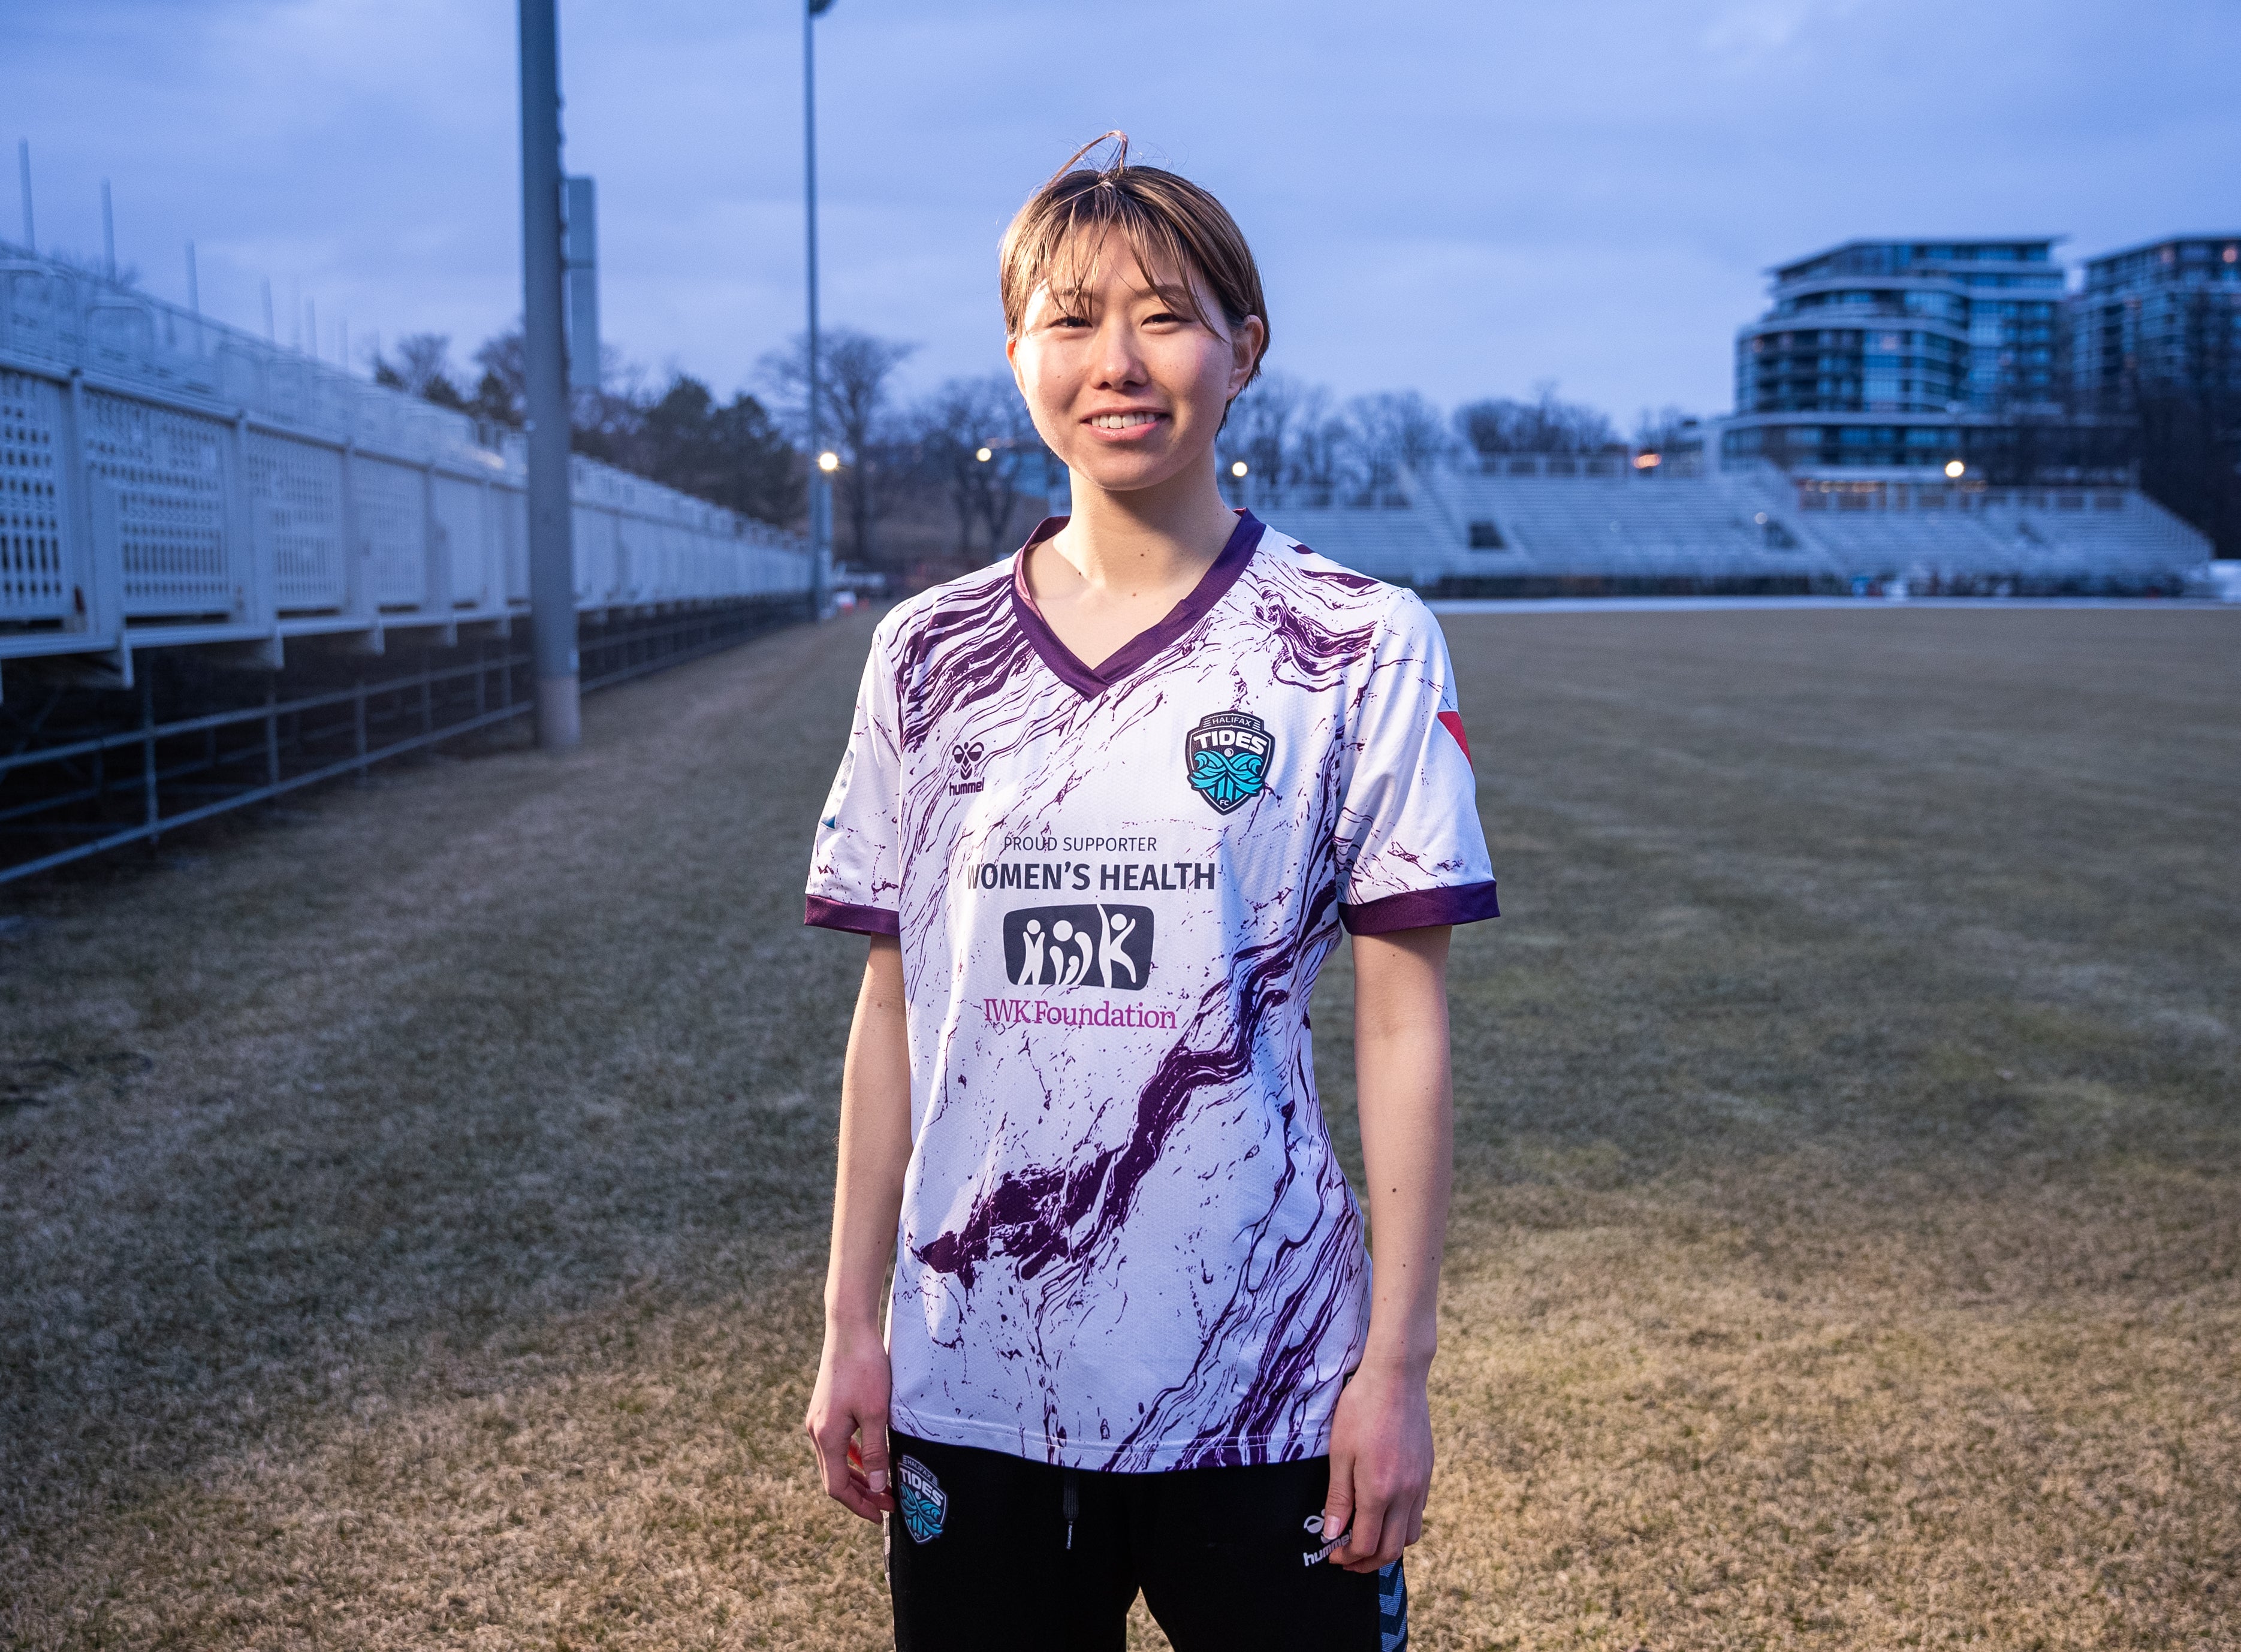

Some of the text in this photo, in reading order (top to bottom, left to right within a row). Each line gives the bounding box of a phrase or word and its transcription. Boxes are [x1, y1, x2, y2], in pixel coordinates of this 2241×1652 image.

[1212, 716, 1252, 727] HALIFAX
[1193, 730, 1268, 755] TIDES
[949, 777, 985, 797] hummel
[1003, 836, 1157, 851] PROUD SUPPORTER
[1100, 863, 1215, 891] HEALTH
[984, 998, 1178, 1029] IWK Foundation
[900, 1467, 944, 1508] TIDES
